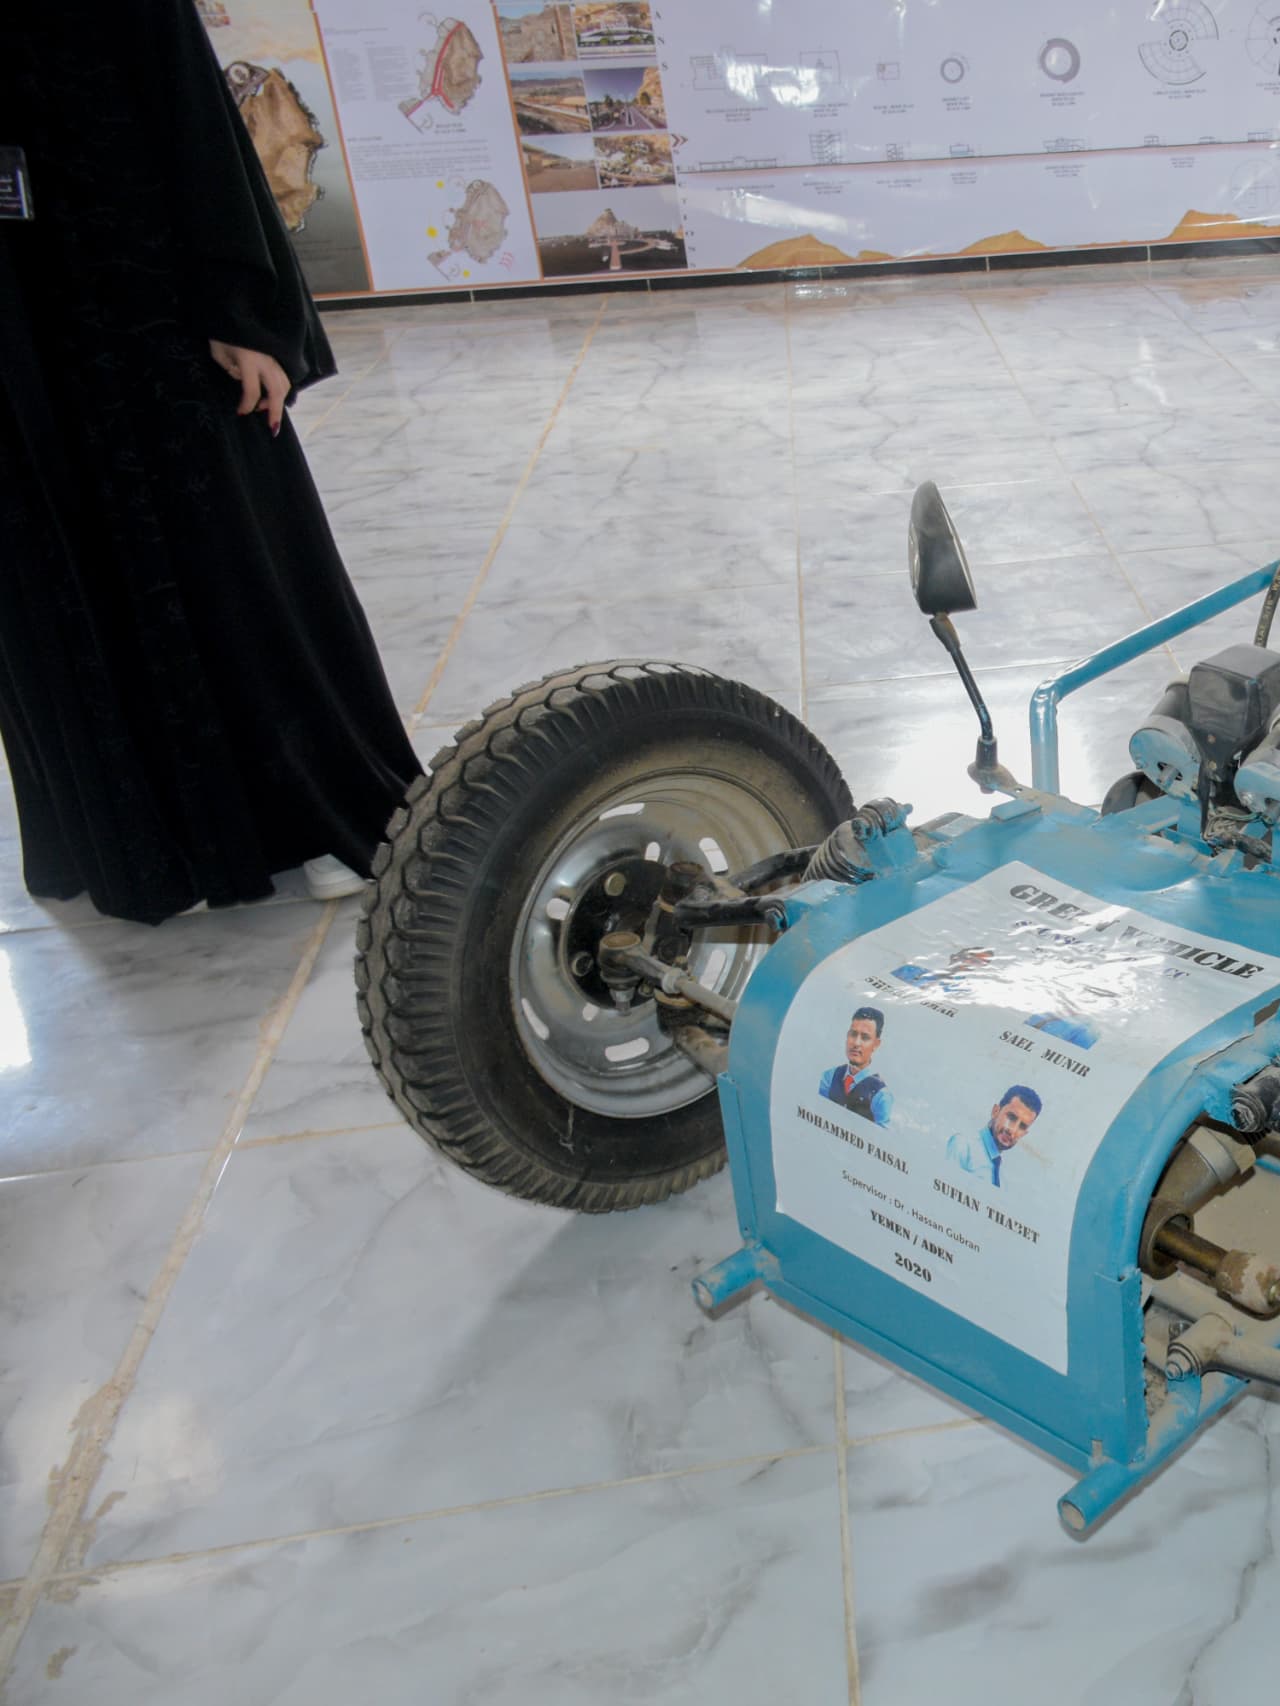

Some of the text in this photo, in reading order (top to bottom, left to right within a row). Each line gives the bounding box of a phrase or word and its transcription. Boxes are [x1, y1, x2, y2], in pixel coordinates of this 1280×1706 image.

[999, 1029, 1091, 1078] SAEL MUNIR
[796, 1105, 909, 1174] MOHAMMED FAISAL
[842, 1169, 887, 1201] Supervisor
[911, 1208, 944, 1233] Hassan
[945, 1227, 980, 1253] Gubran
[932, 1178, 980, 1212] SUFIAN
[870, 1208, 911, 1241] YEMEN
[921, 1238, 954, 1265] ADEN
[894, 1252, 932, 1283] 2020
